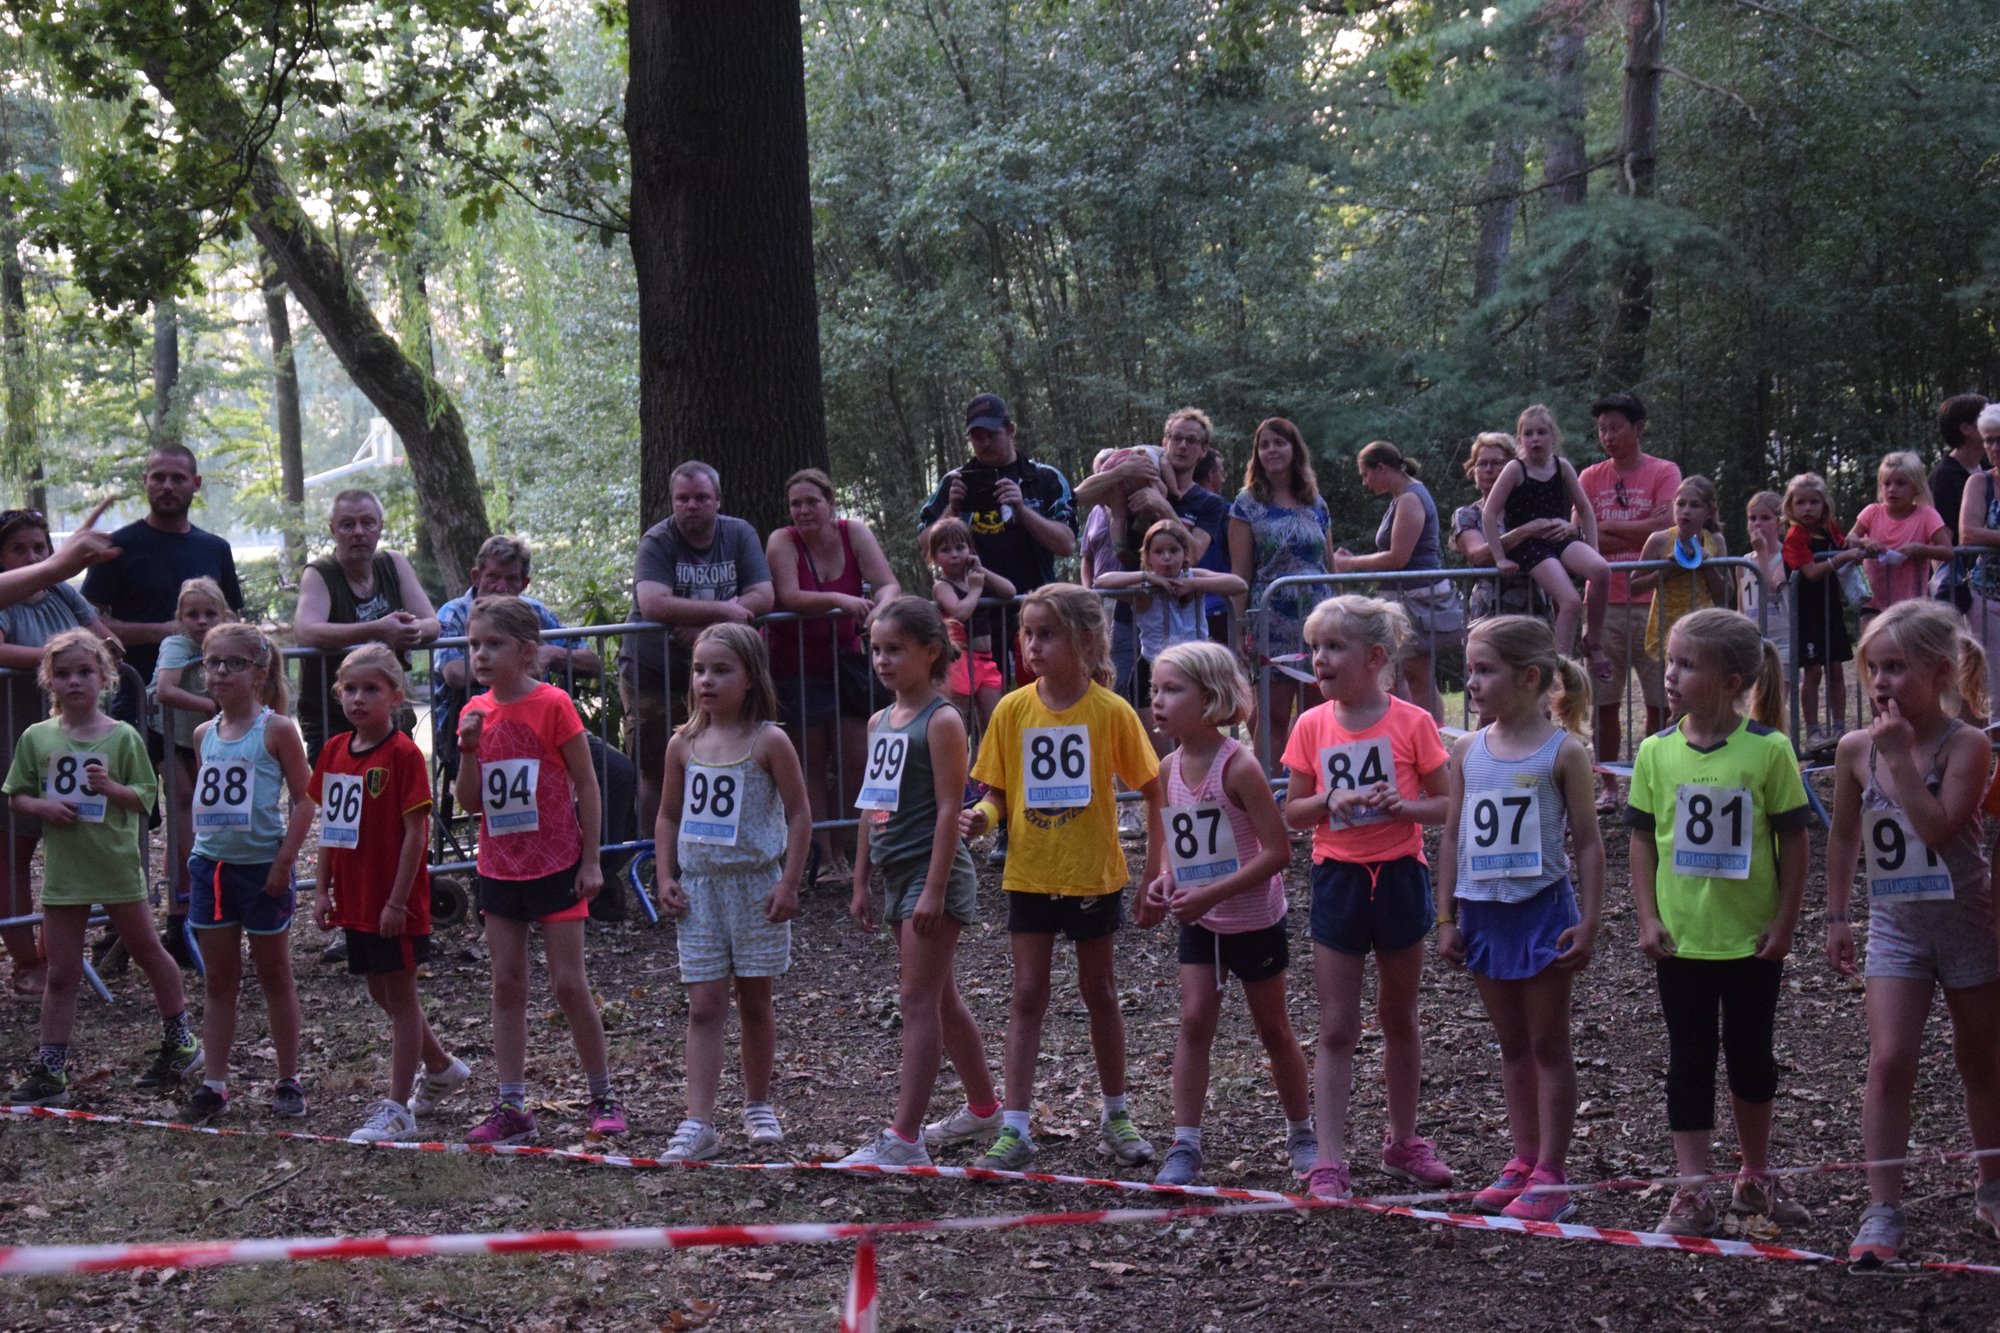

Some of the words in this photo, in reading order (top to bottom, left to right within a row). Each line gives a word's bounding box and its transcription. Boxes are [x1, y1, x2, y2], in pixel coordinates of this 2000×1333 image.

[870, 738, 904, 781] 99
[1031, 733, 1085, 780] 86
[1328, 746, 1388, 790] 84
[200, 766, 247, 806] 88
[327, 781, 361, 823] 96
[488, 765, 531, 810] 94
[690, 772, 736, 818] 98
[1172, 808, 1221, 859] 87
[1474, 796, 1531, 848] 97
[1686, 794, 1742, 847] 81
